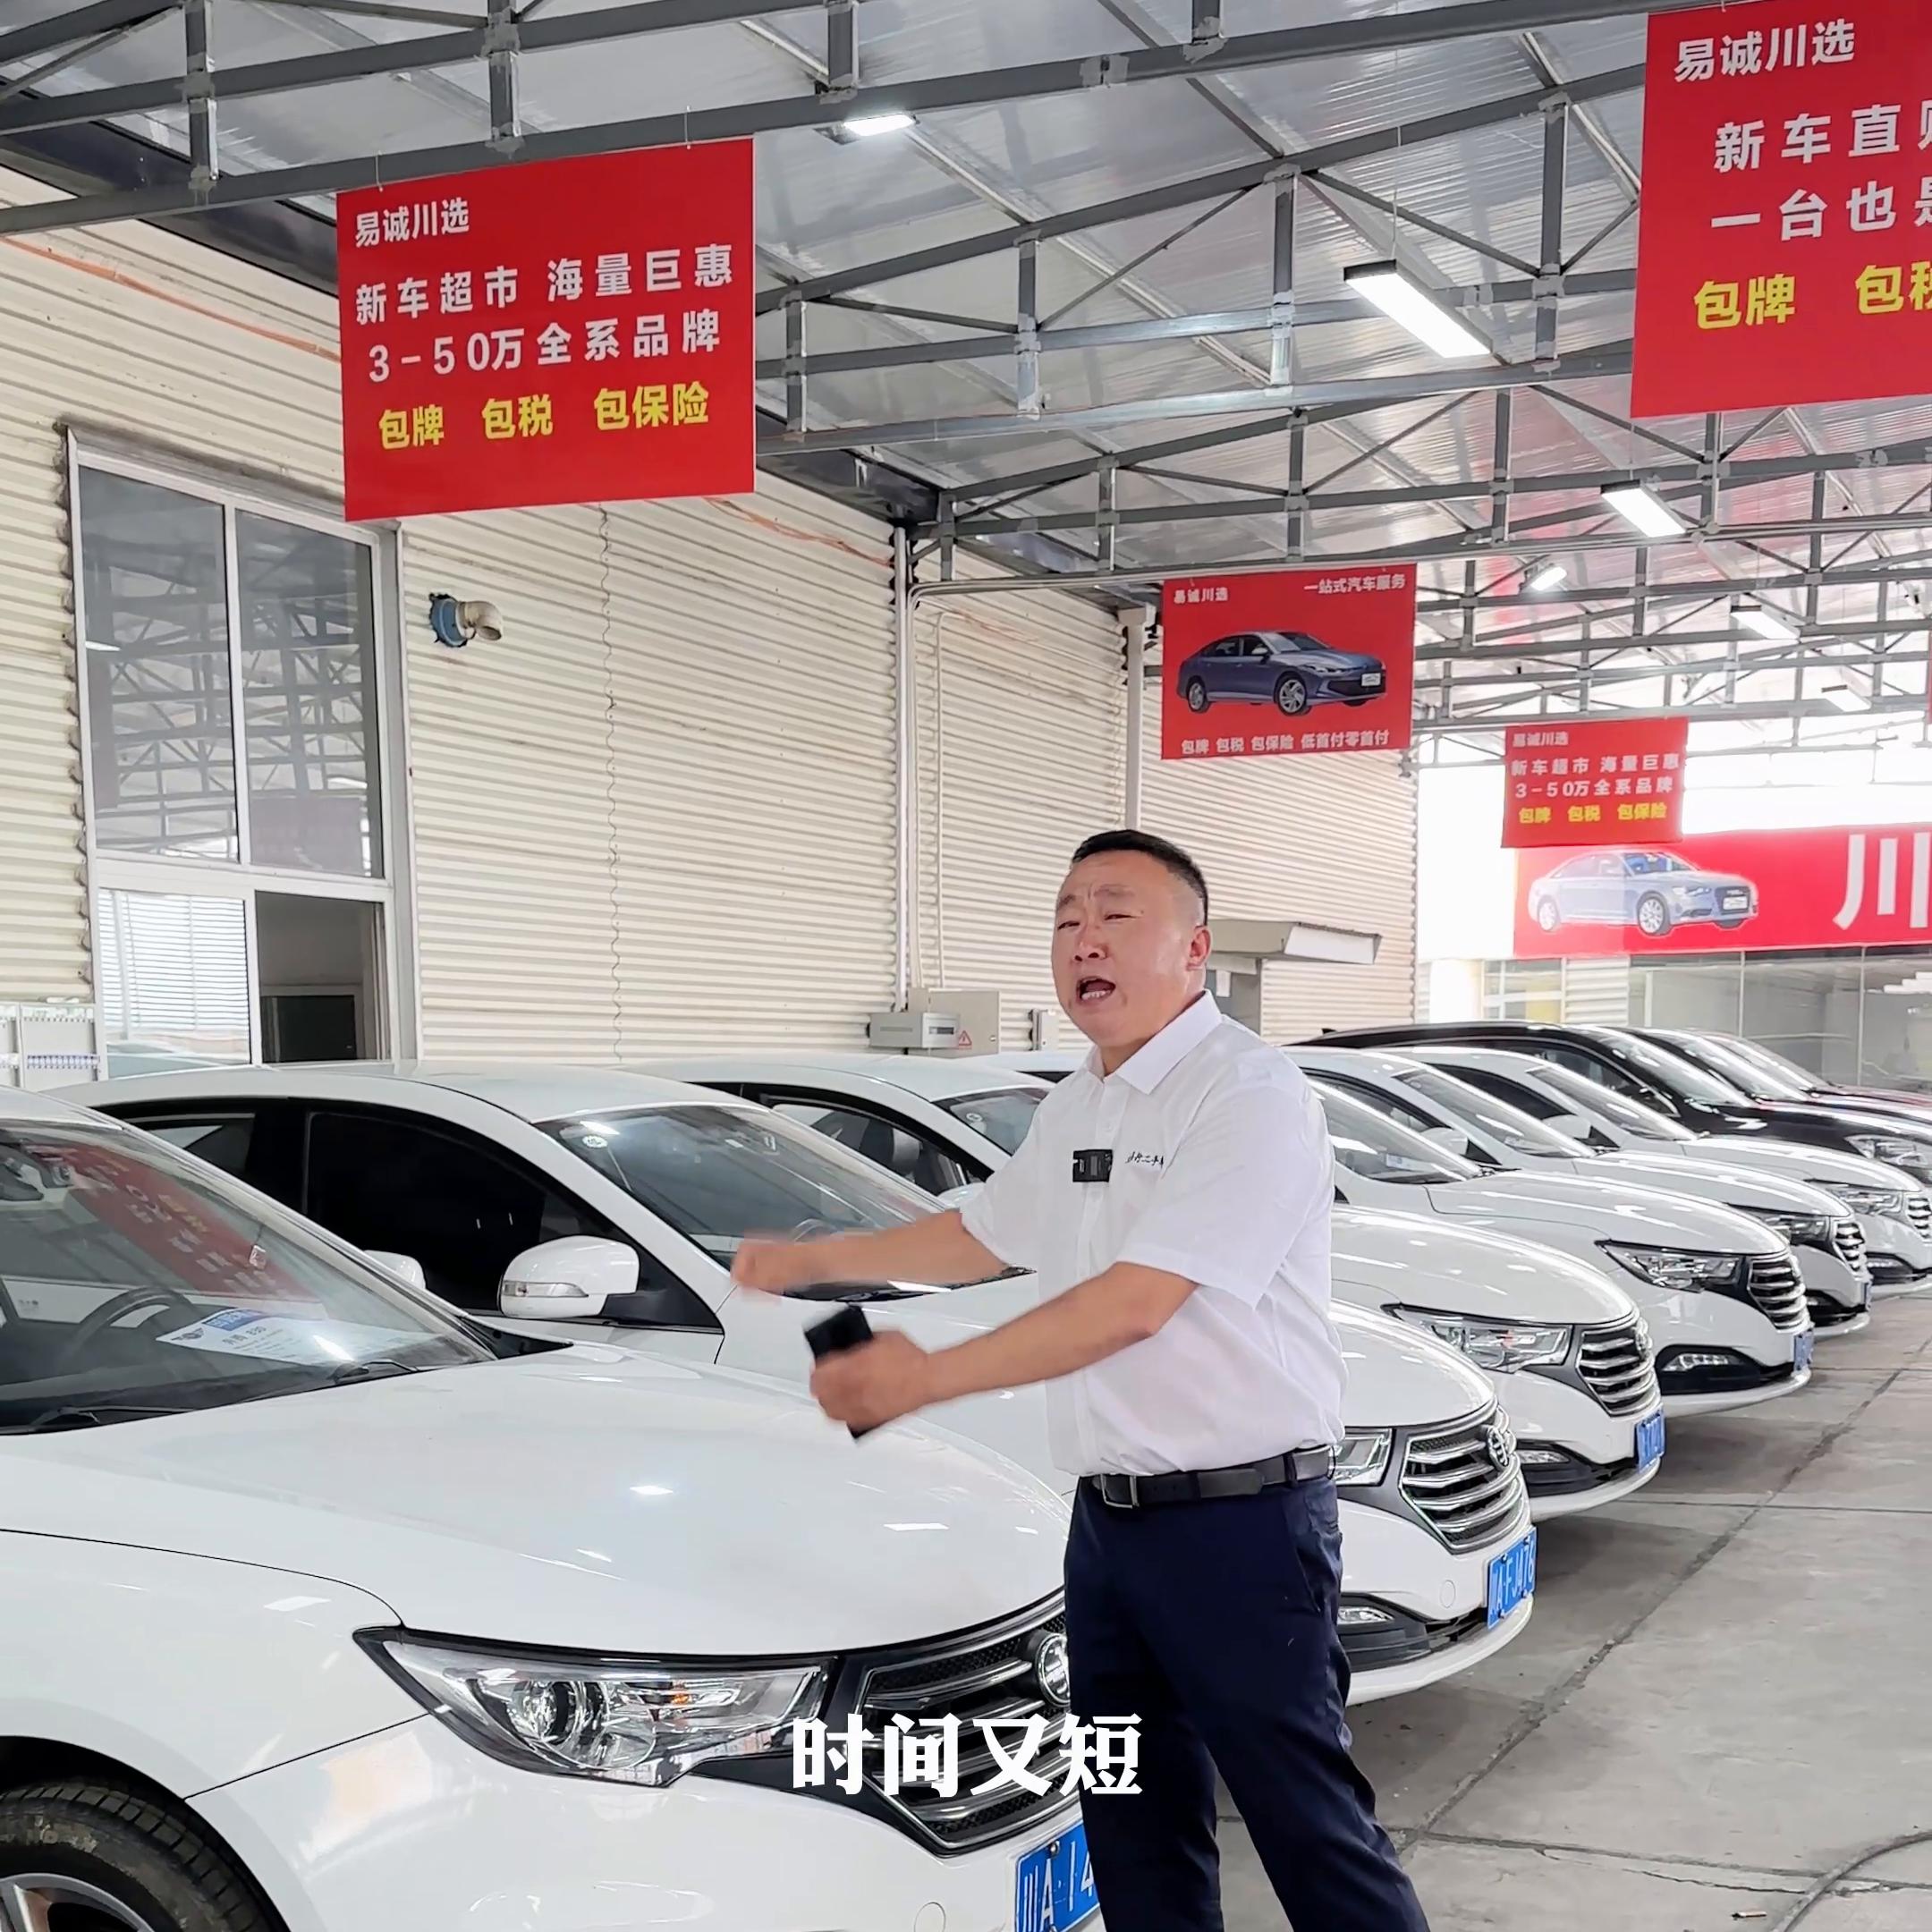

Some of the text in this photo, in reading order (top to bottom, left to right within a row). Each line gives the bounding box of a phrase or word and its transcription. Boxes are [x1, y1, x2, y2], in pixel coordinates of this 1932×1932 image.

[1674, 19, 1854, 81] 易诚川选
[356, 198, 469, 247] 易诚川选
[356, 244, 732, 325] 新车超市 海量巨惠
[1694, 274, 1794, 329] 包牌
[379, 381, 708, 449] 包牌 包税 包保险
[1174, 574, 1405, 603] 易诚川选 一站式汽车服务
[1182, 731, 1389, 754] 包牌 包税 包保险 低首付零首付
[1519, 802, 1667, 823] 包牌 包税 包保险
[1832, 831, 1931, 930] 川
